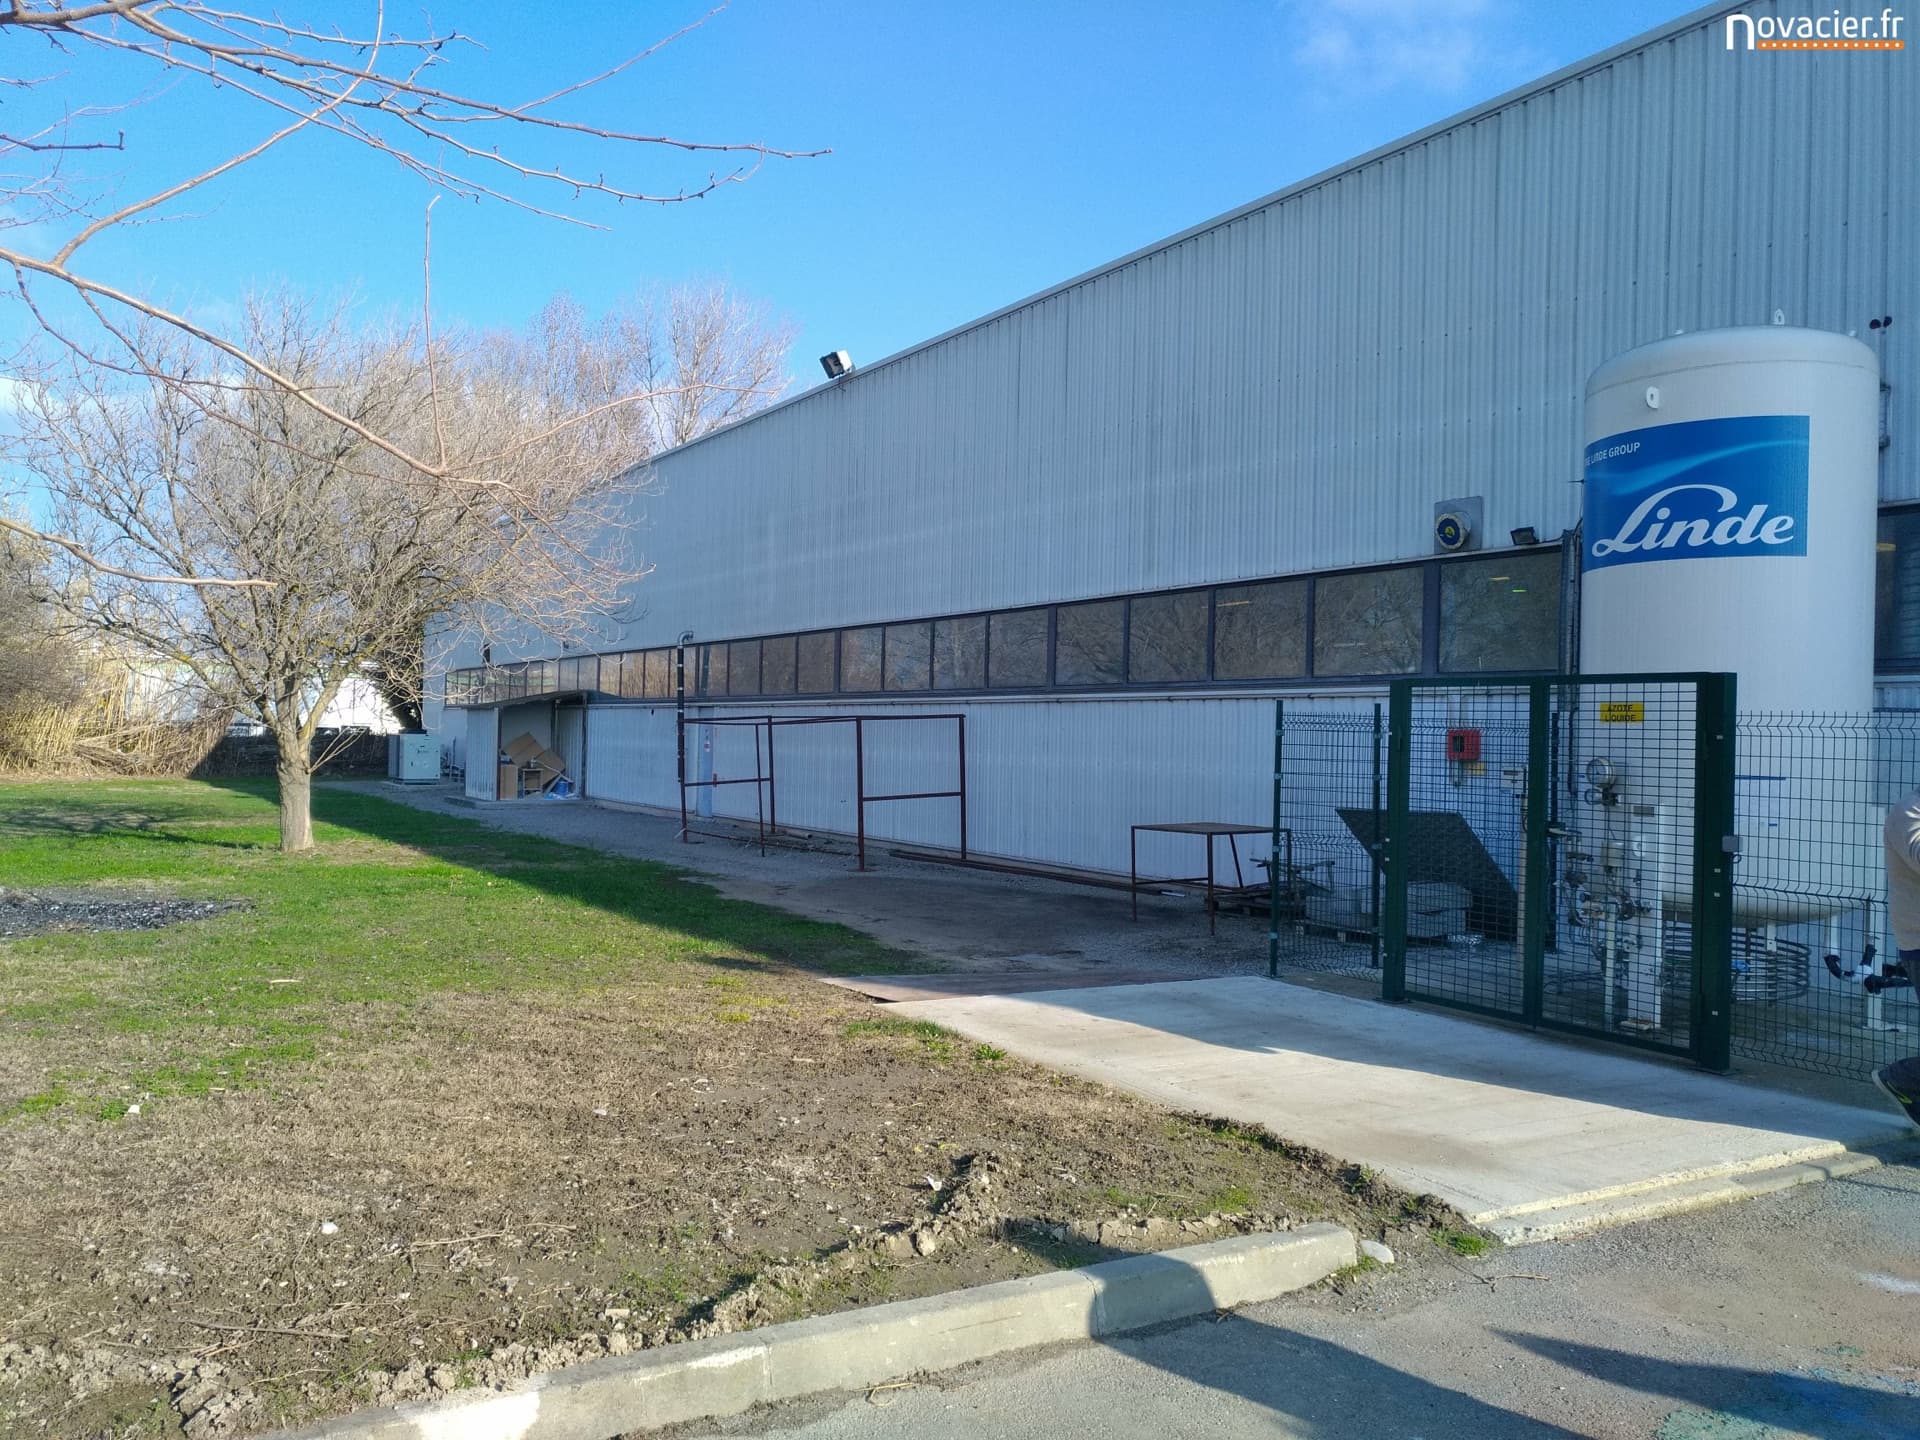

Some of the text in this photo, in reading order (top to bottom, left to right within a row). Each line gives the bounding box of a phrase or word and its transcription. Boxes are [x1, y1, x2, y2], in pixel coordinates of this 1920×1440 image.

[1608, 441, 1641, 458] GROUP
[1592, 483, 1794, 558] Linde
[1607, 703, 1633, 711] AZOTE
